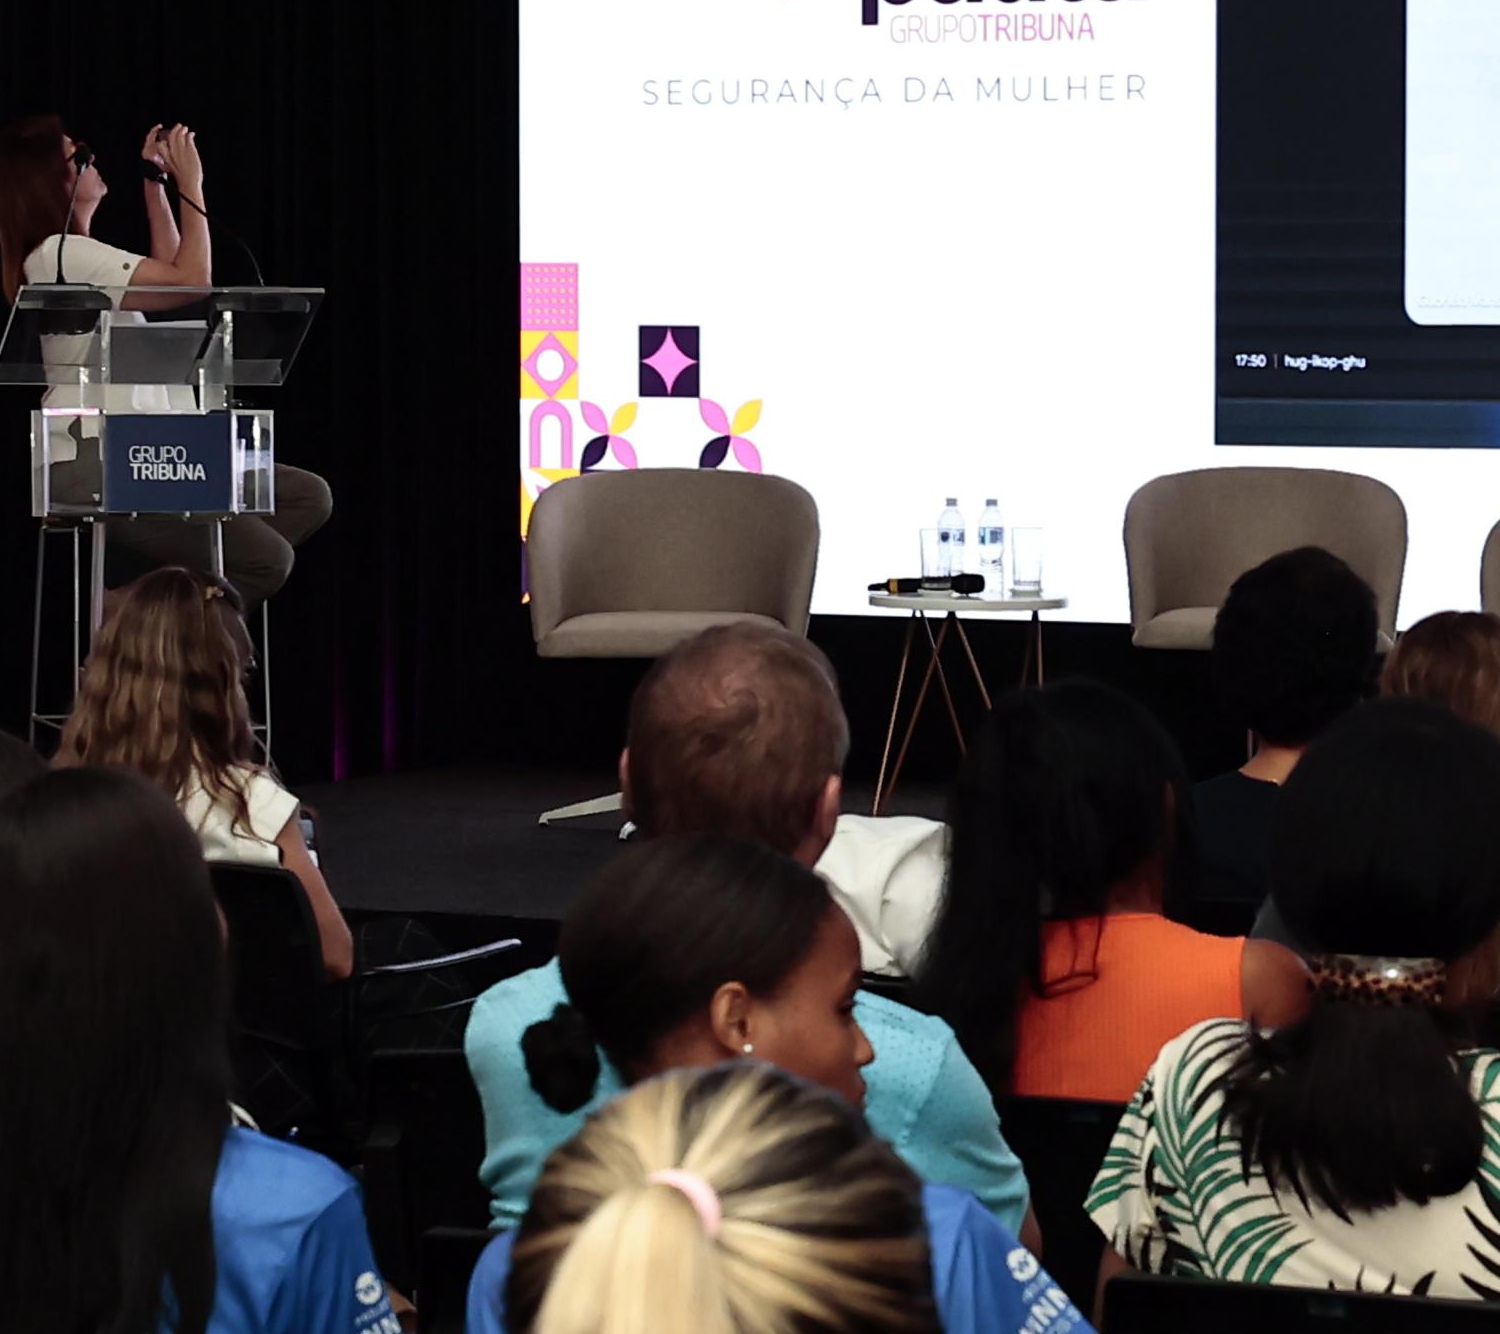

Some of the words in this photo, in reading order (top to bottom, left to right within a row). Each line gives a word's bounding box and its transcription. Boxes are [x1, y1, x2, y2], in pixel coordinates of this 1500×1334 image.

[642, 77, 882, 111] SEGURANÇA
[903, 75, 955, 104] DA
[975, 73, 1147, 103] MULHER
[1235, 353, 1267, 369] 17:50
[128, 445, 187, 463] GRUPO
[129, 463, 206, 481] TRIBUNA
